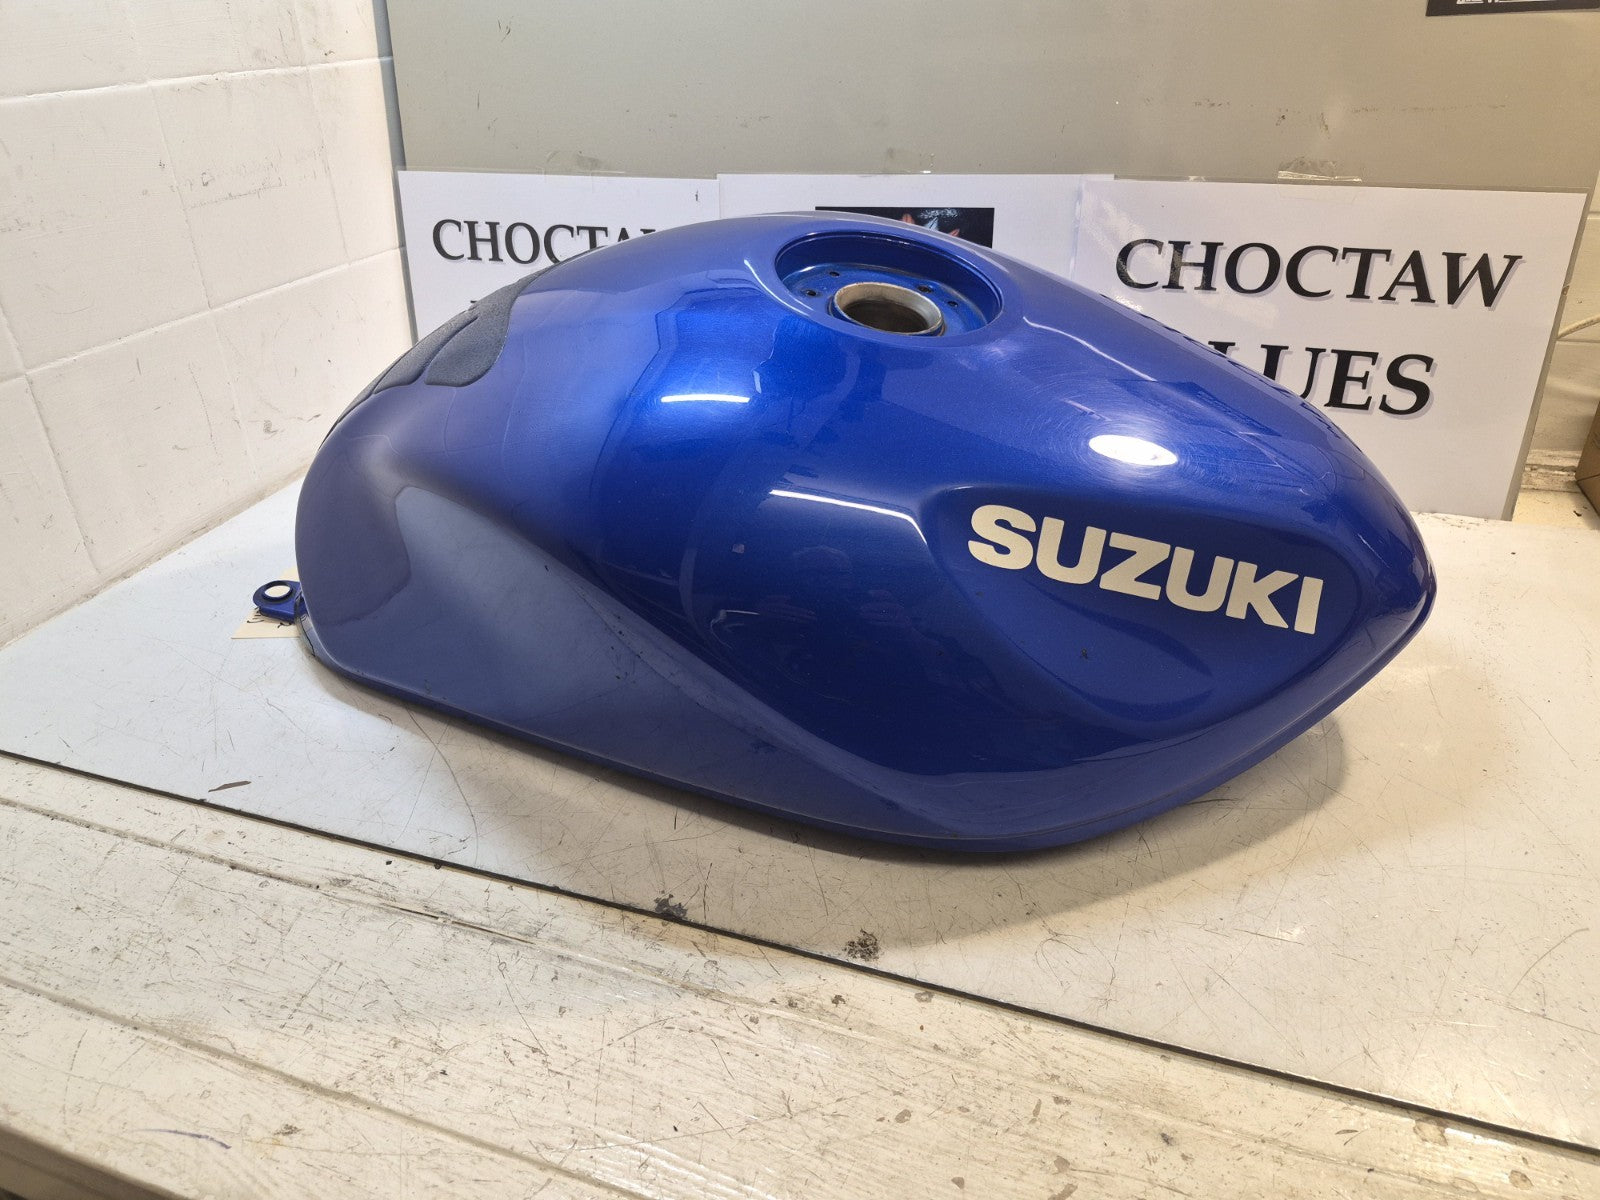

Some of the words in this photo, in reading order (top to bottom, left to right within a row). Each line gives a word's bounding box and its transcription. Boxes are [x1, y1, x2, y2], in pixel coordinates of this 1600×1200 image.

[432, 218, 656, 265] CHOCT
[1115, 238, 1523, 308] CHOCTAW
[1207, 340, 1435, 416] UES
[967, 504, 1324, 635] SUZUKI
